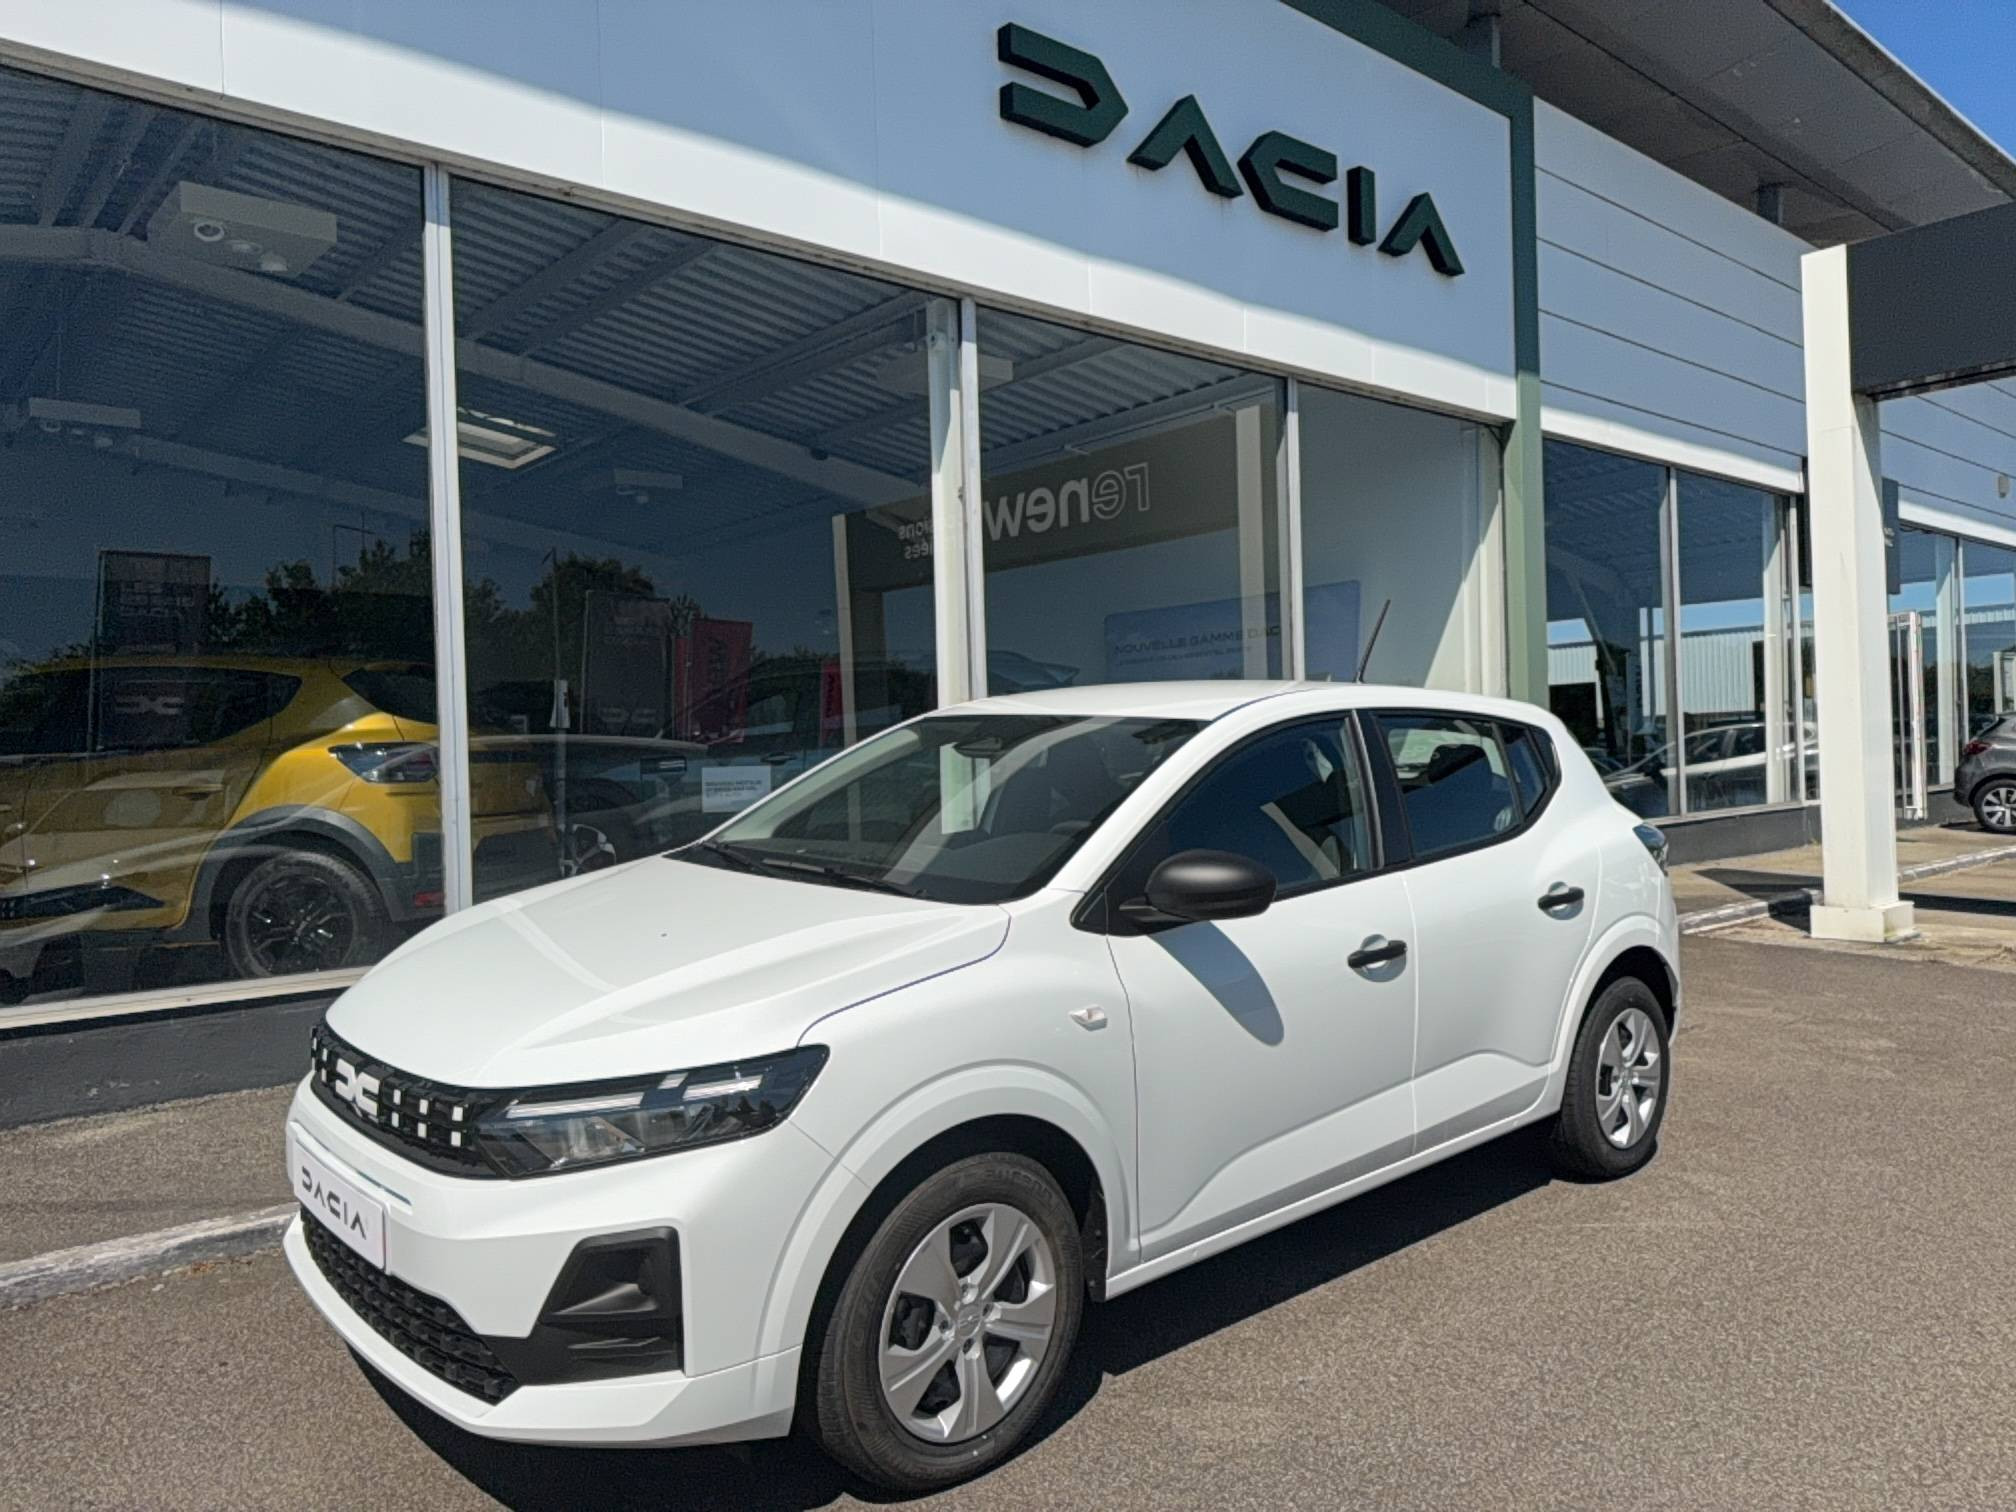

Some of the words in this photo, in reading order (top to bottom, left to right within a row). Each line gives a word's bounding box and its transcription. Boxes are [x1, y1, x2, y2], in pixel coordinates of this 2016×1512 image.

[997, 21, 1465, 277] DACIA
[1114, 636, 1187, 656] NOUVELLE
[1189, 630, 1242, 647] GAMME
[302, 1166, 367, 1241] DACIA
